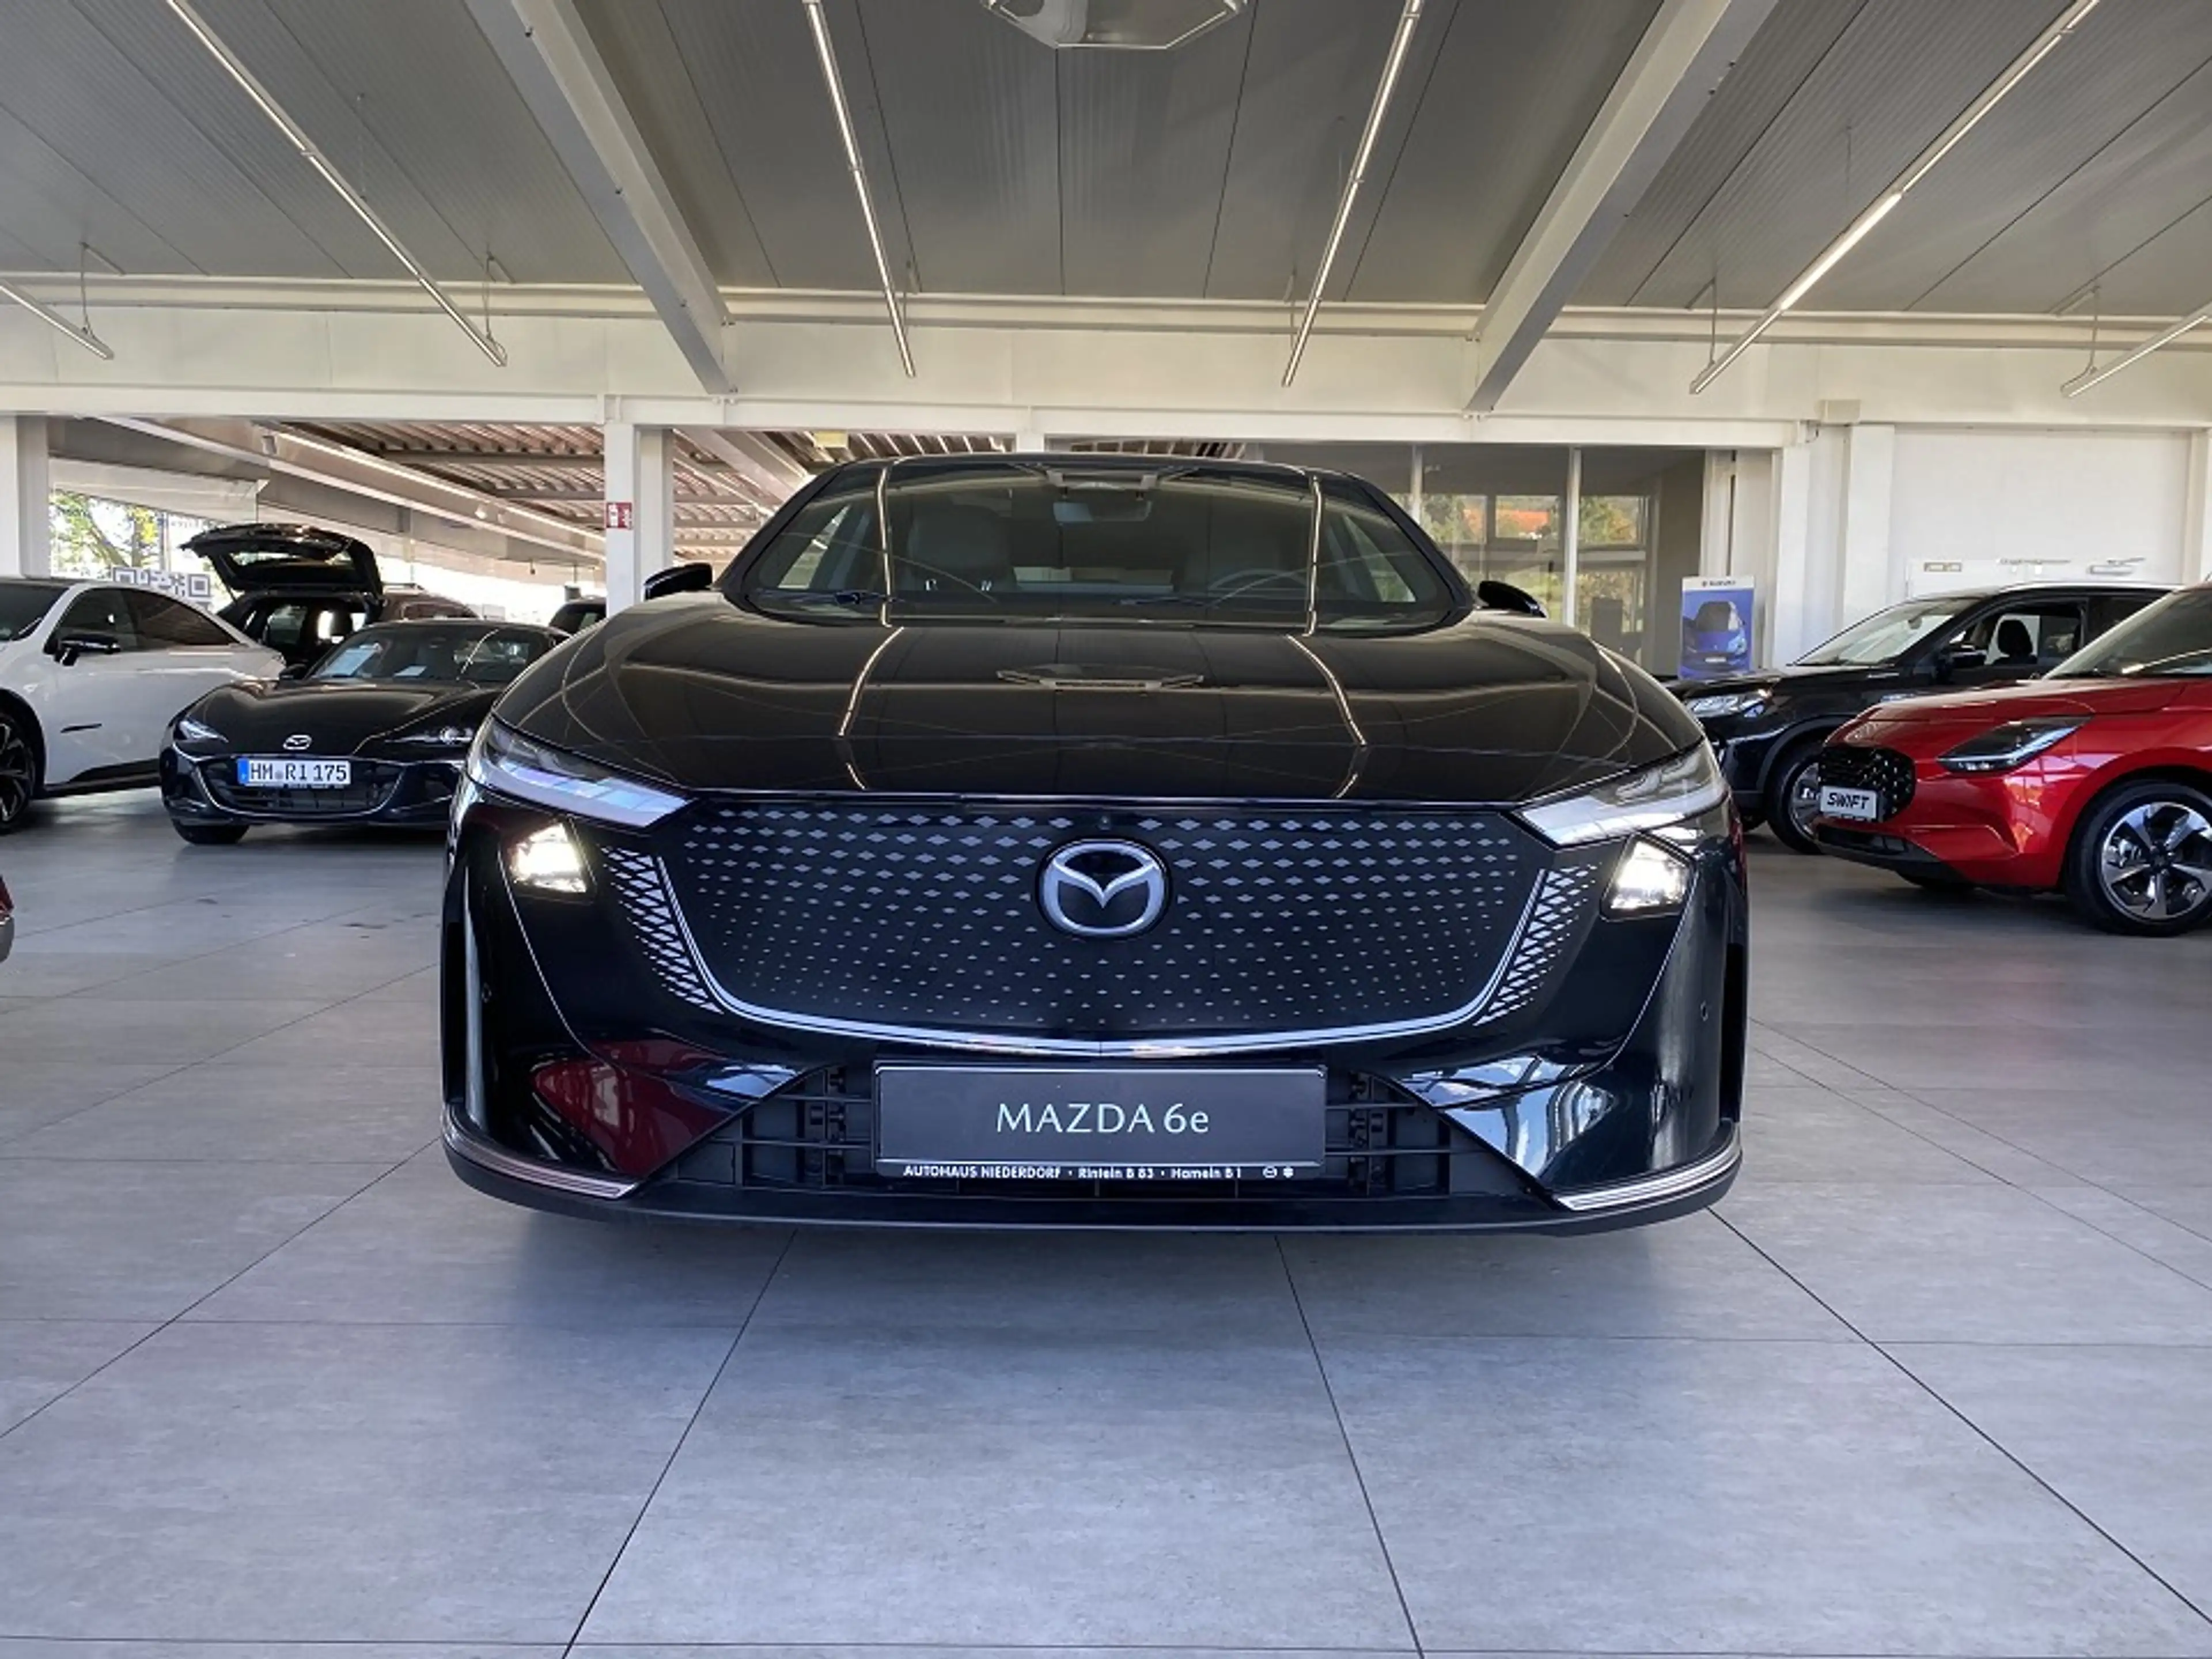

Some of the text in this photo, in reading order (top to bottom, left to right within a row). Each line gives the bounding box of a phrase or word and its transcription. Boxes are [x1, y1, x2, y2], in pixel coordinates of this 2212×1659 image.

[251, 763, 347, 782] HM RI 175
[1827, 792, 1870, 810] SWIFT
[997, 1103, 1209, 1133] MAZDA 6e
[903, 1165, 978, 1178] AUTOHAUS
[981, 1165, 1061, 1179] NIEDERDORF
